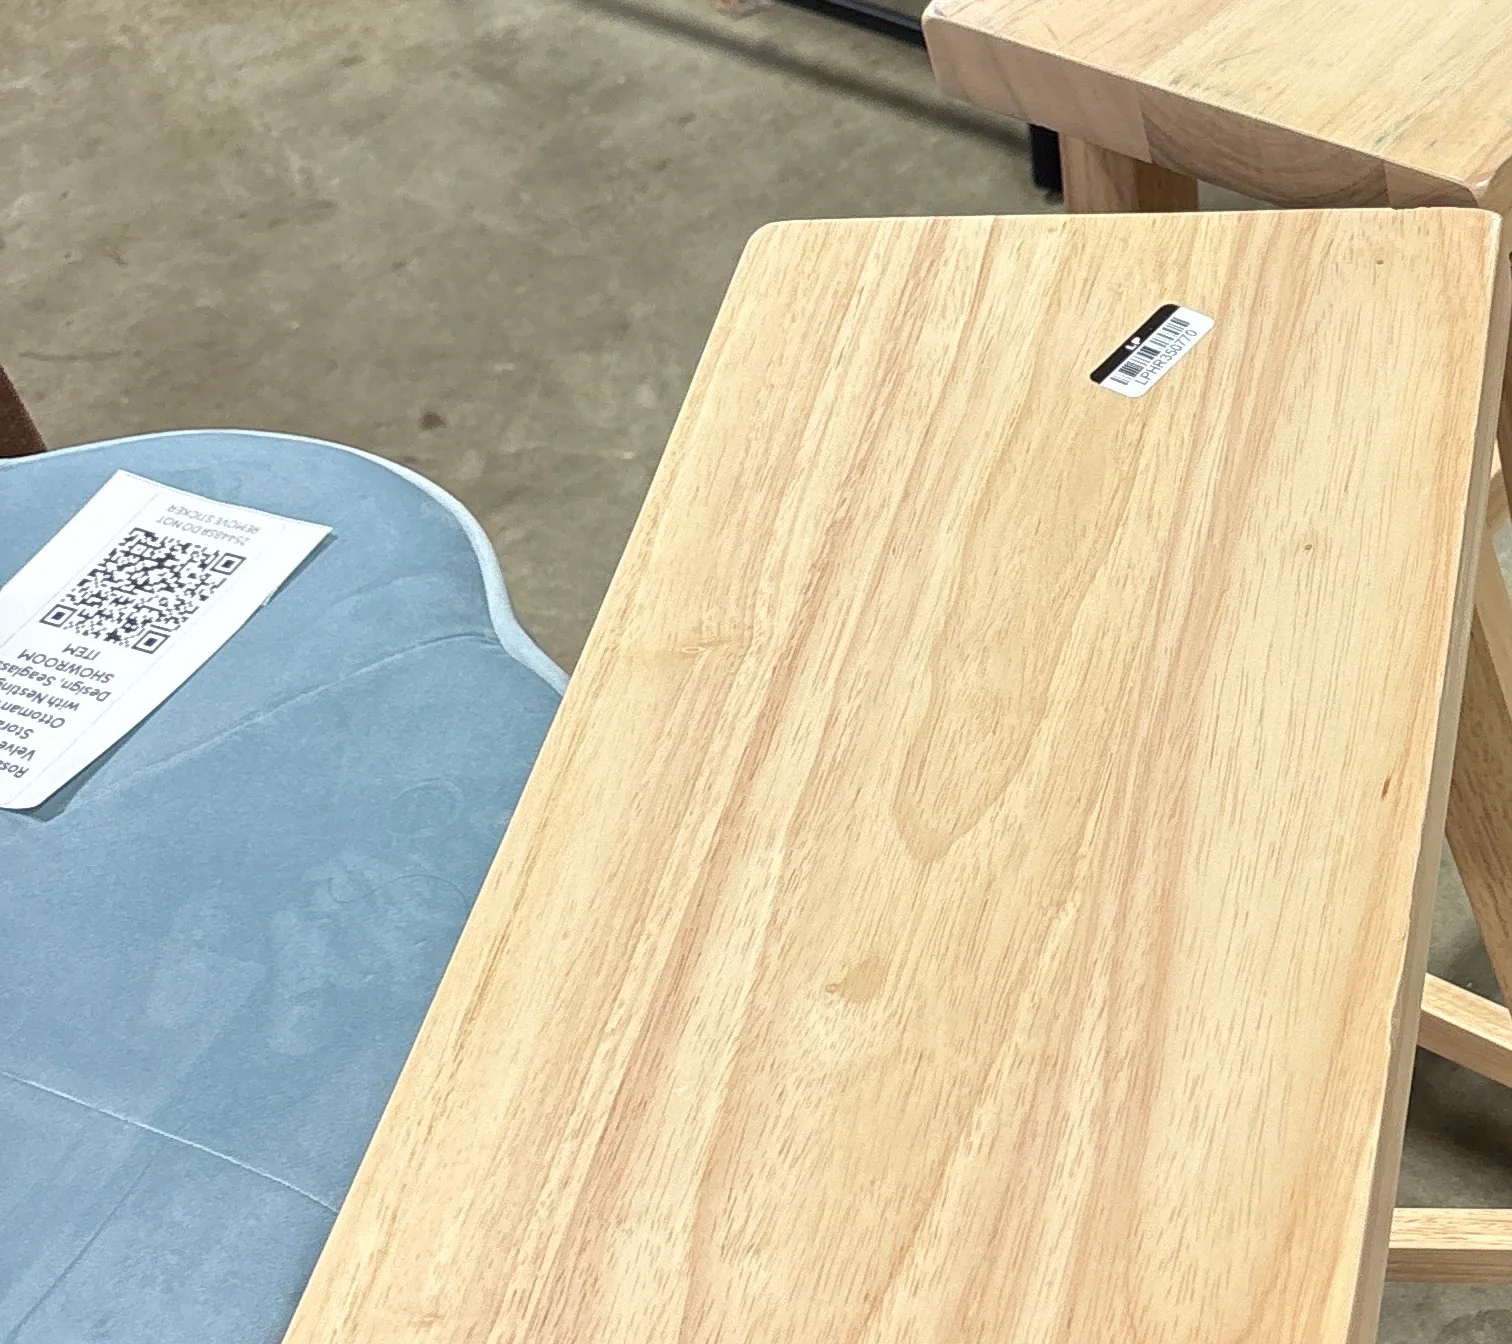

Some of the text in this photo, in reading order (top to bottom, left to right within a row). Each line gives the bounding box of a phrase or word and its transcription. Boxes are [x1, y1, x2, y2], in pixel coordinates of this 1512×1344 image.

[1125, 336, 1141, 351] LP
[1134, 329, 1198, 386] LPHR350770
[156, 516, 183, 528] NOT
[167, 504, 261, 534] REMOVE STICKER
[182, 522, 201, 534] DO
[62, 643, 101, 661] ITEM
[17, 649, 115, 684] SHOWROOM
[60, 678, 112, 702] Design,
[47, 696, 80, 711] with
